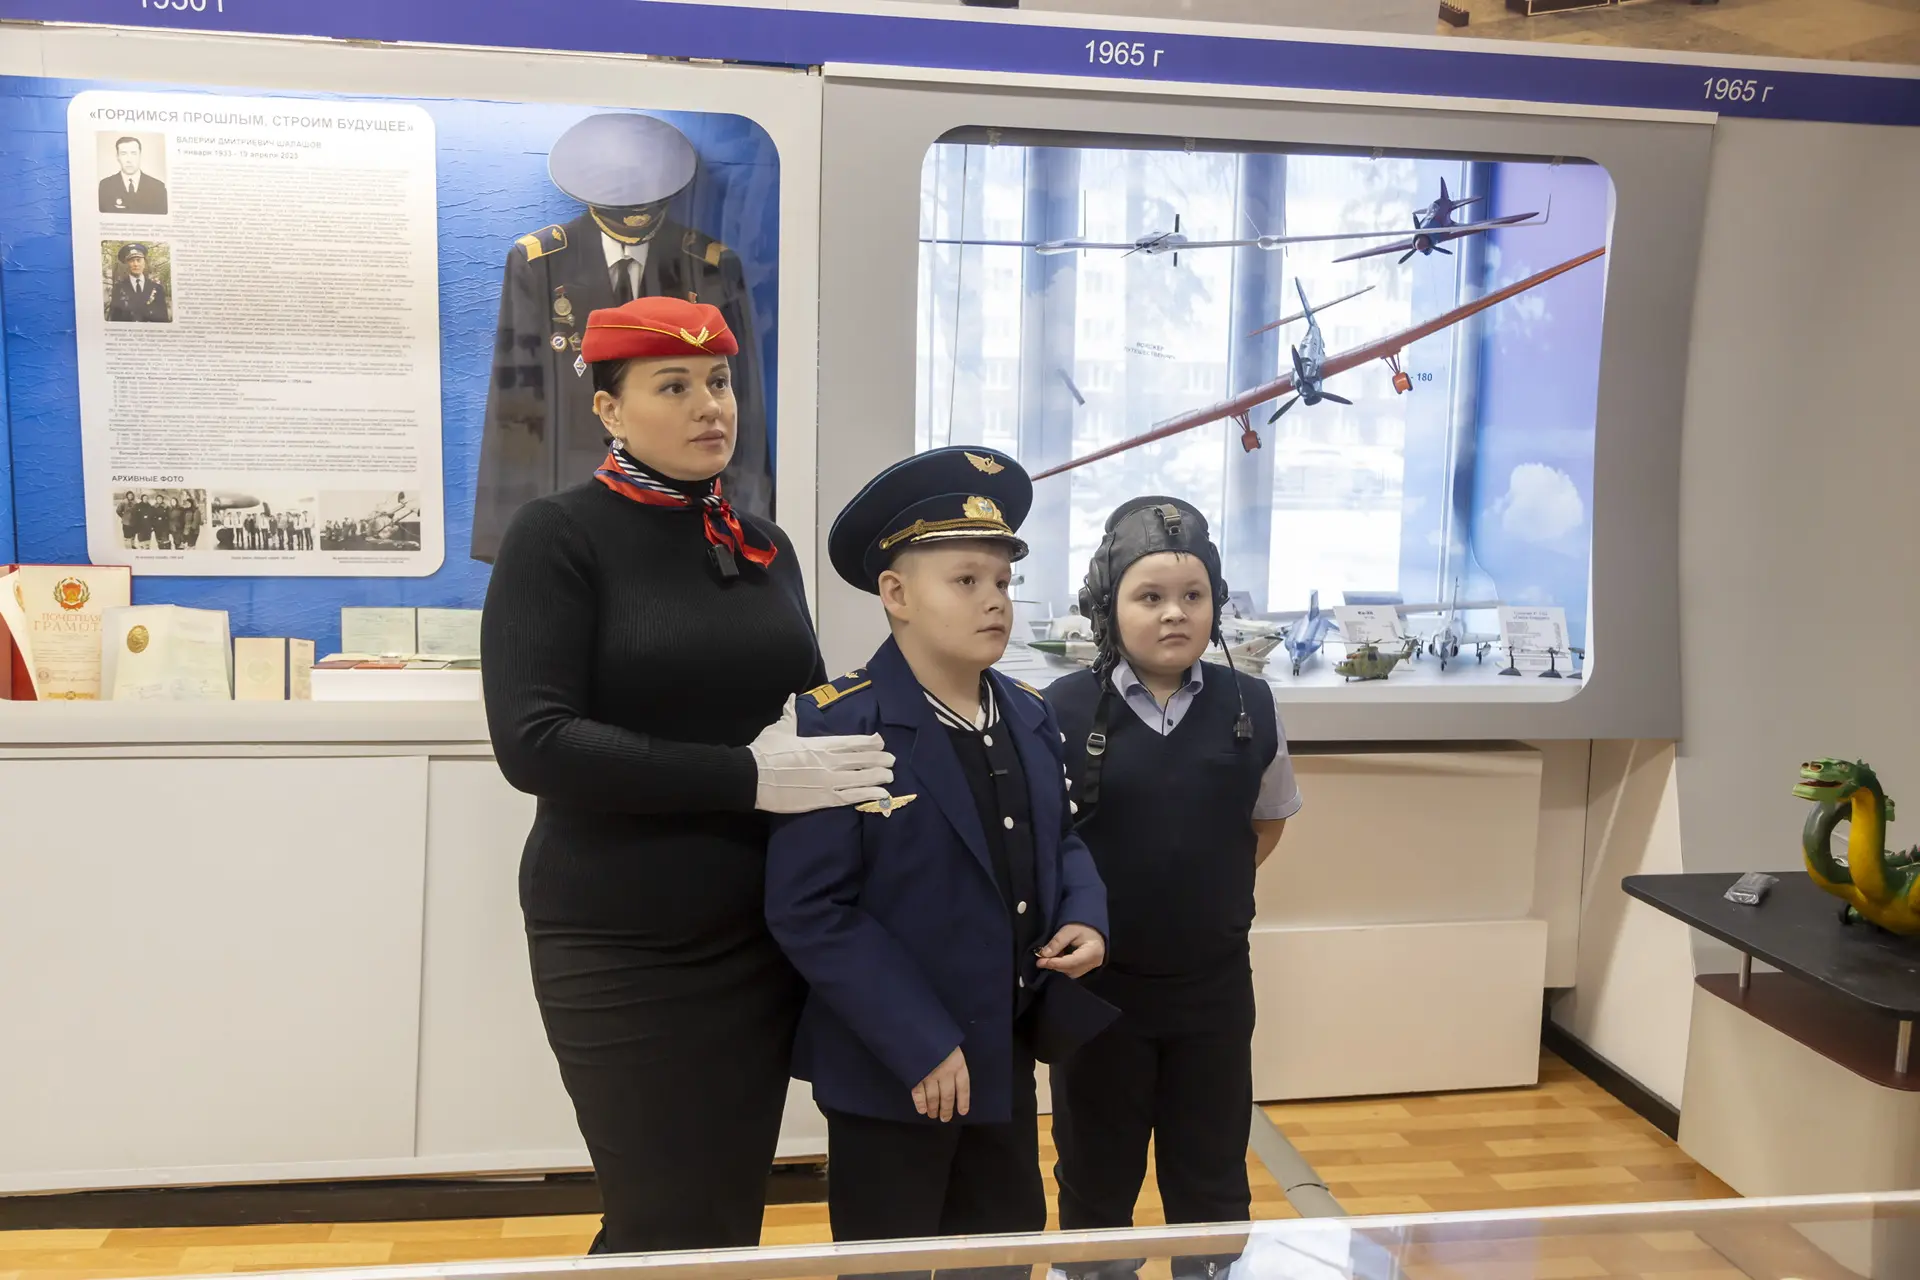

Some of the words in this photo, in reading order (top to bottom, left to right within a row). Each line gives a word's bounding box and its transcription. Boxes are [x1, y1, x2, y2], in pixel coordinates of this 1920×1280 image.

[1085, 40, 1145, 66] 1965
[1153, 50, 1164, 67] г
[1703, 77, 1757, 102] 1965
[1761, 86, 1774, 103] г
[90, 108, 178, 123] «ГОРДИМСЯ
[272, 115, 333, 129] СТРОИМ
[337, 118, 414, 132] БУДУЩЕЕ»
[218, 137, 274, 147] ДМИТРИЕВИЧ
[1417, 372, 1433, 382] 180
[111, 474, 159, 483] АРХИВНЫЕ
[160, 475, 185, 484] ФОТО
